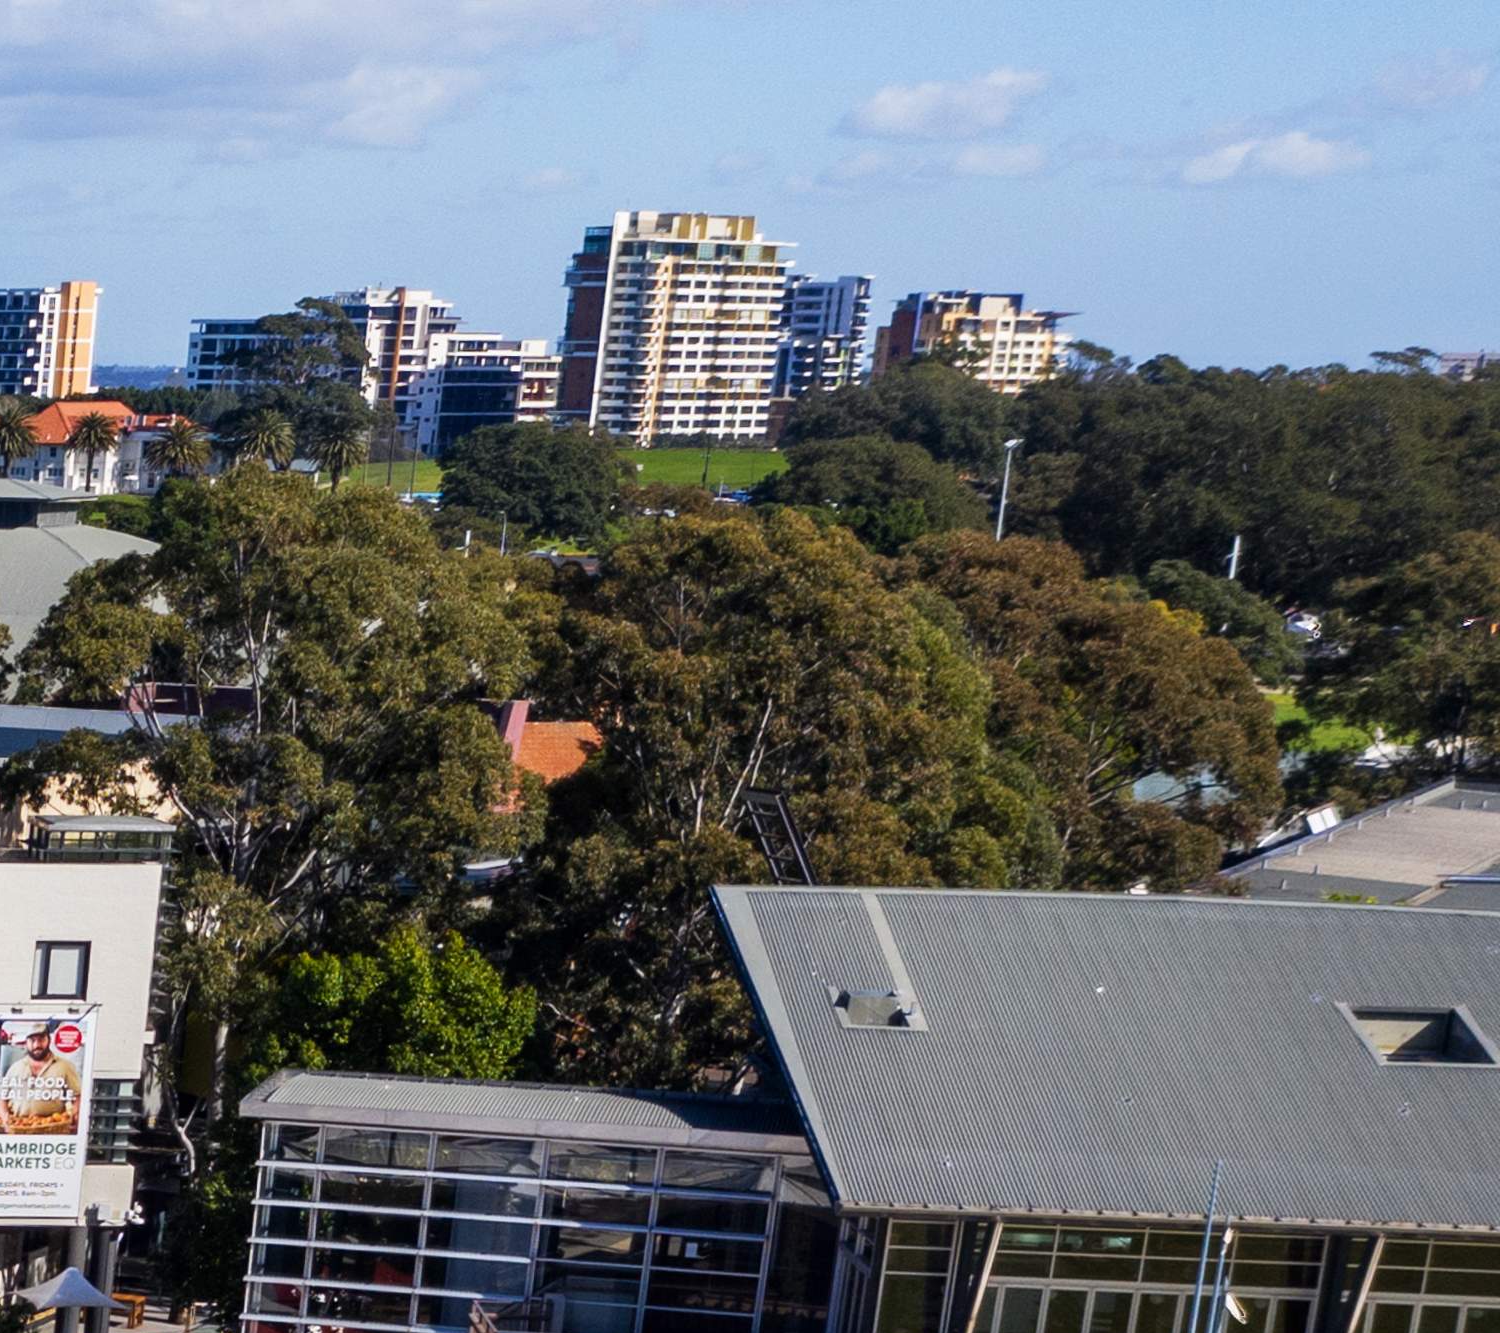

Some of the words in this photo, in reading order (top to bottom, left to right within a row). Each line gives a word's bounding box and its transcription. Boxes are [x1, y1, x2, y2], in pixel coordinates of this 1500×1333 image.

[28, 1077, 68, 1088] FOOD.
[27, 1089, 77, 1101] PEOPLE.
[54, 1158, 76, 1169] EQ
